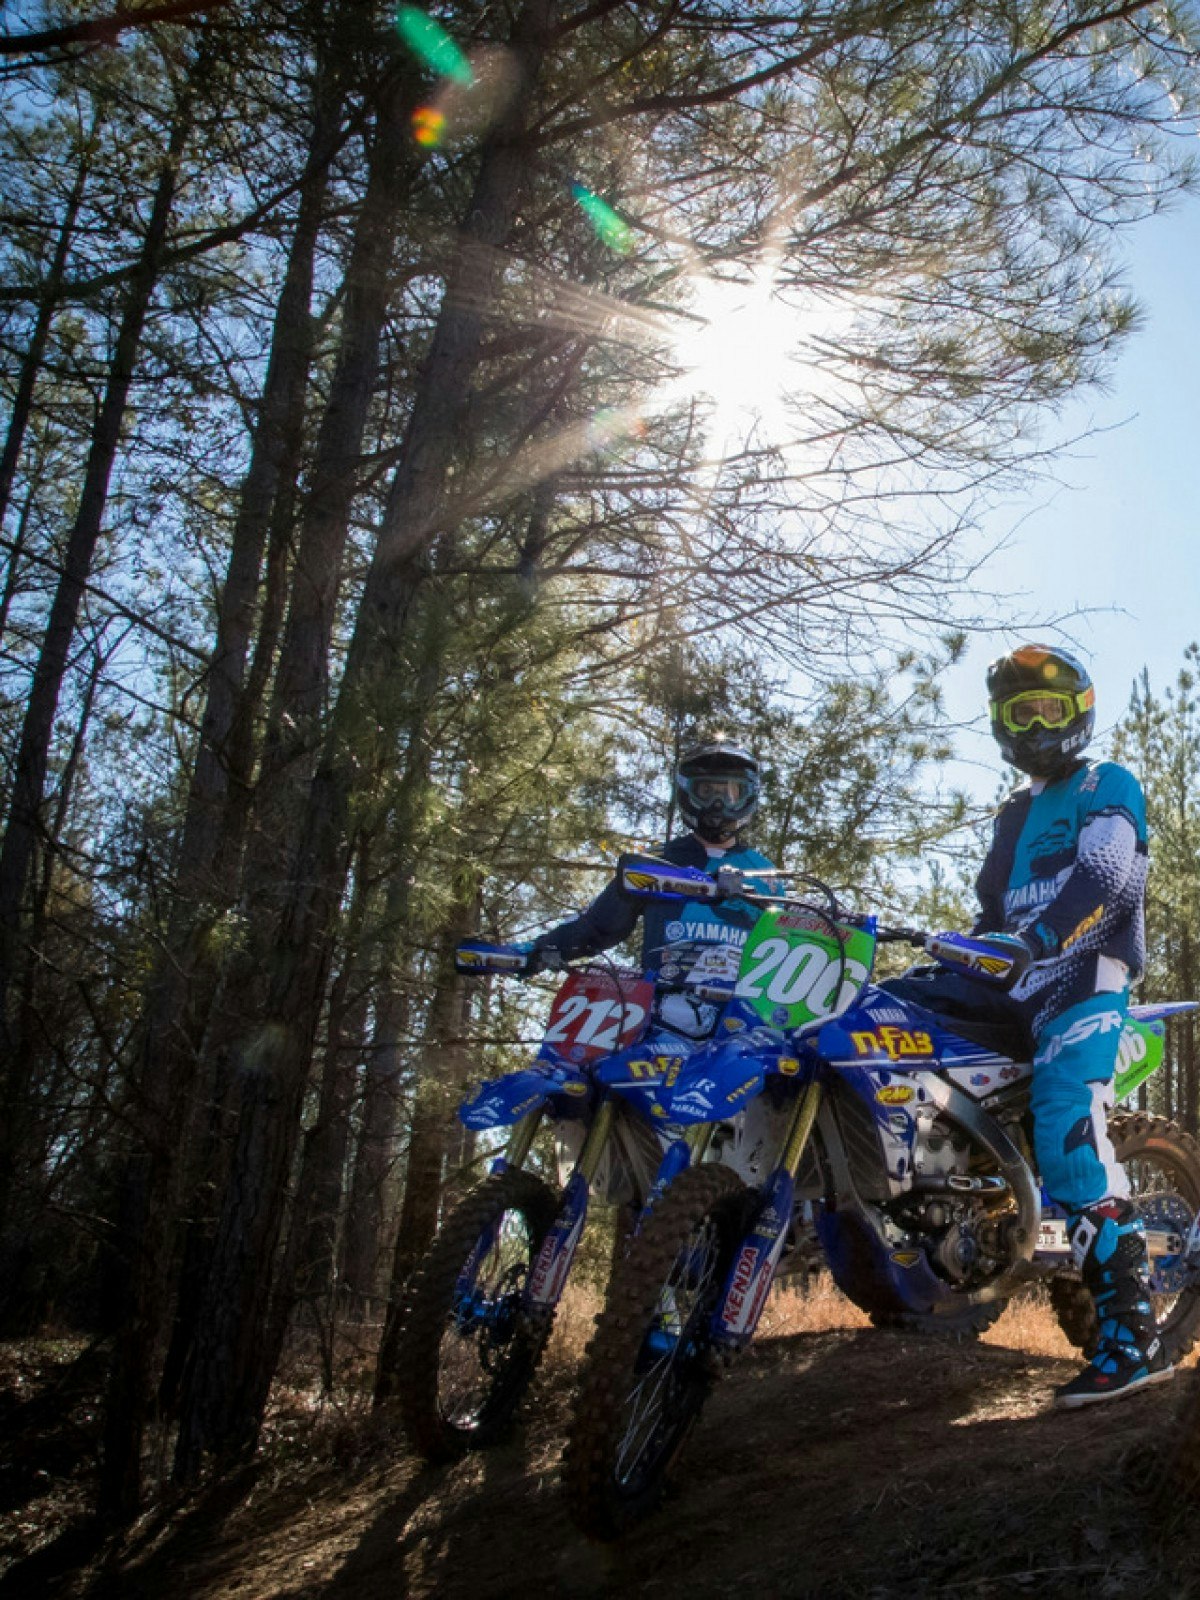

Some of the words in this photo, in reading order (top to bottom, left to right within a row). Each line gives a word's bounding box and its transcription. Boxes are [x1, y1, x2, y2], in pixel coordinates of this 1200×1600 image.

[735, 937, 869, 1017] 206
[543, 995, 646, 1050] 212
[721, 1246, 758, 1326] KENDA
